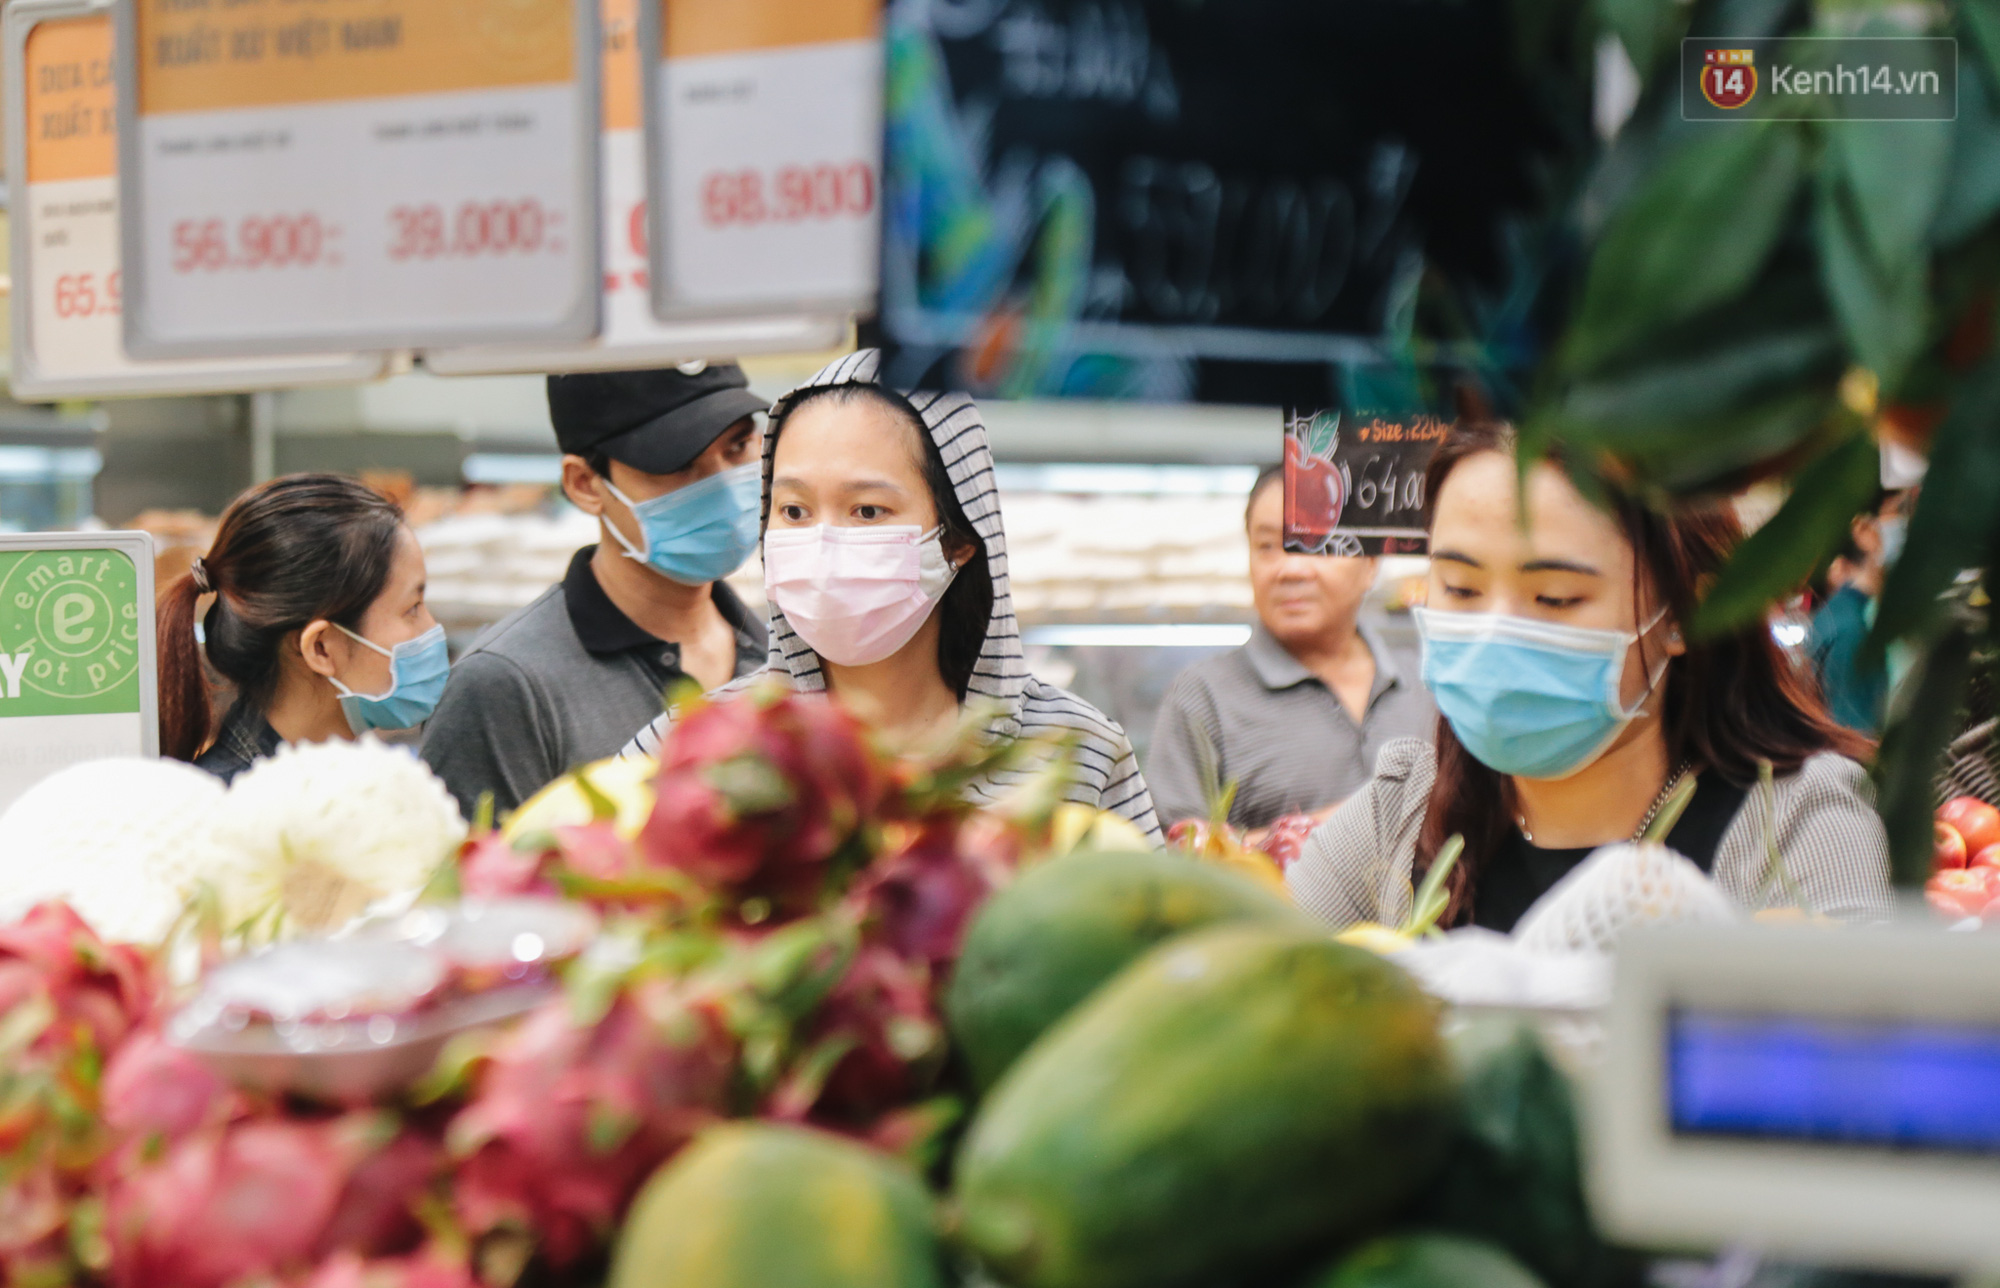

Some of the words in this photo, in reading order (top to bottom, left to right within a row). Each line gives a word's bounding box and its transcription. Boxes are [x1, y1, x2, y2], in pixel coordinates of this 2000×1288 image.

[702, 159, 876, 231] 68.900
[1373, 418, 1403, 442] Size
[14, 556, 111, 610] emart
[53, 593, 96, 644] e
[87, 602, 138, 689] price
